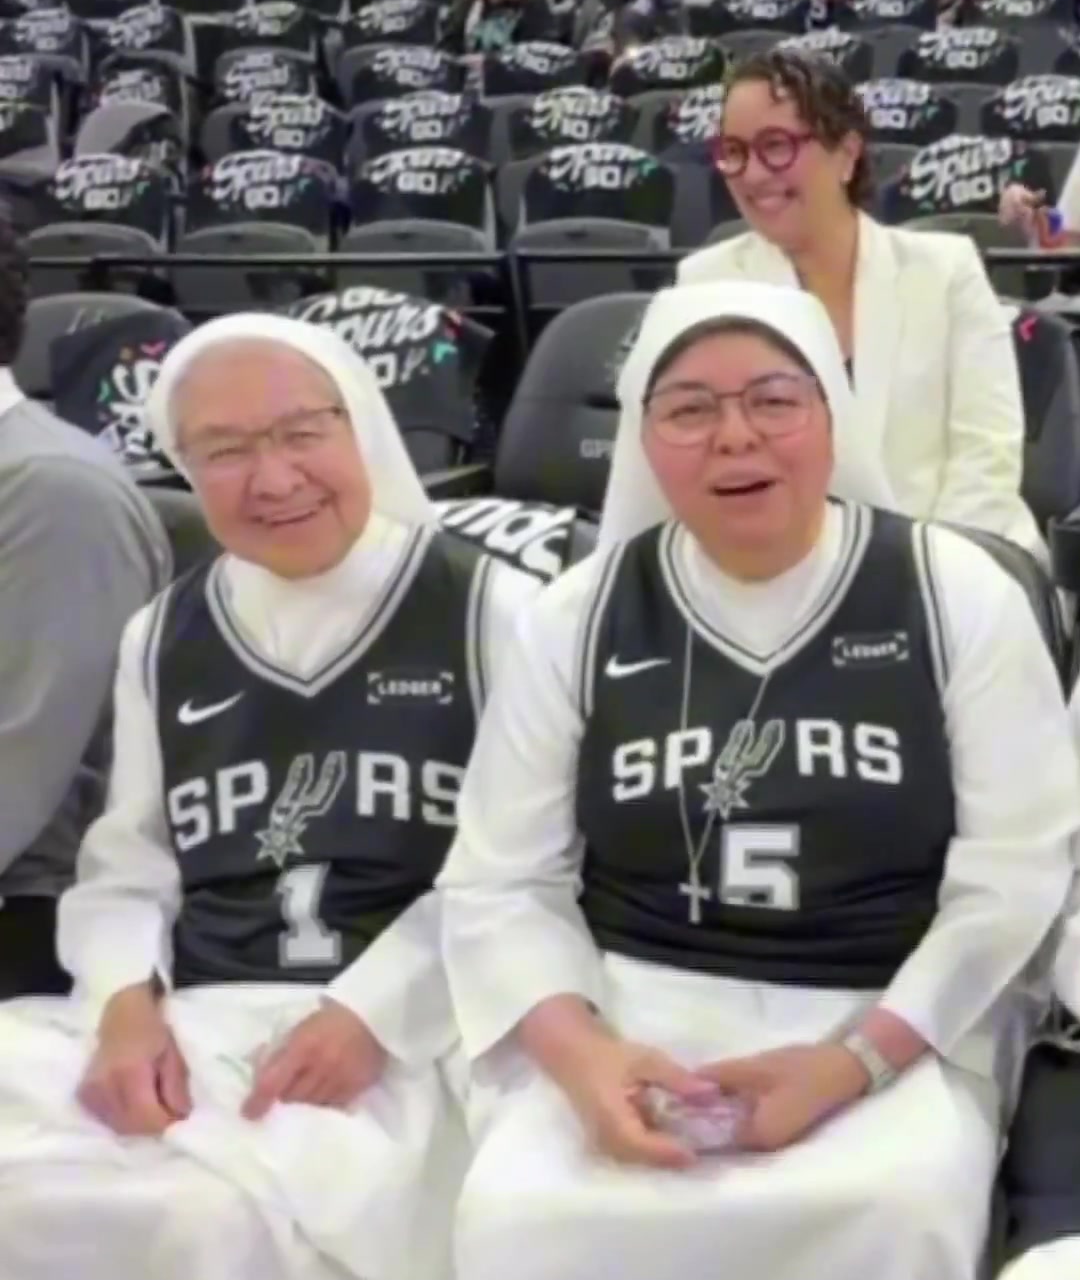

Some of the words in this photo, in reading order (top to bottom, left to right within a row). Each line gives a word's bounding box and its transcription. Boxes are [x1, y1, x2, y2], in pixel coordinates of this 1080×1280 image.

[842, 642, 899, 660] LEDGER
[377, 678, 442, 696] LEDGER
[719, 822, 800, 911] 5
[276, 862, 342, 968] 1
